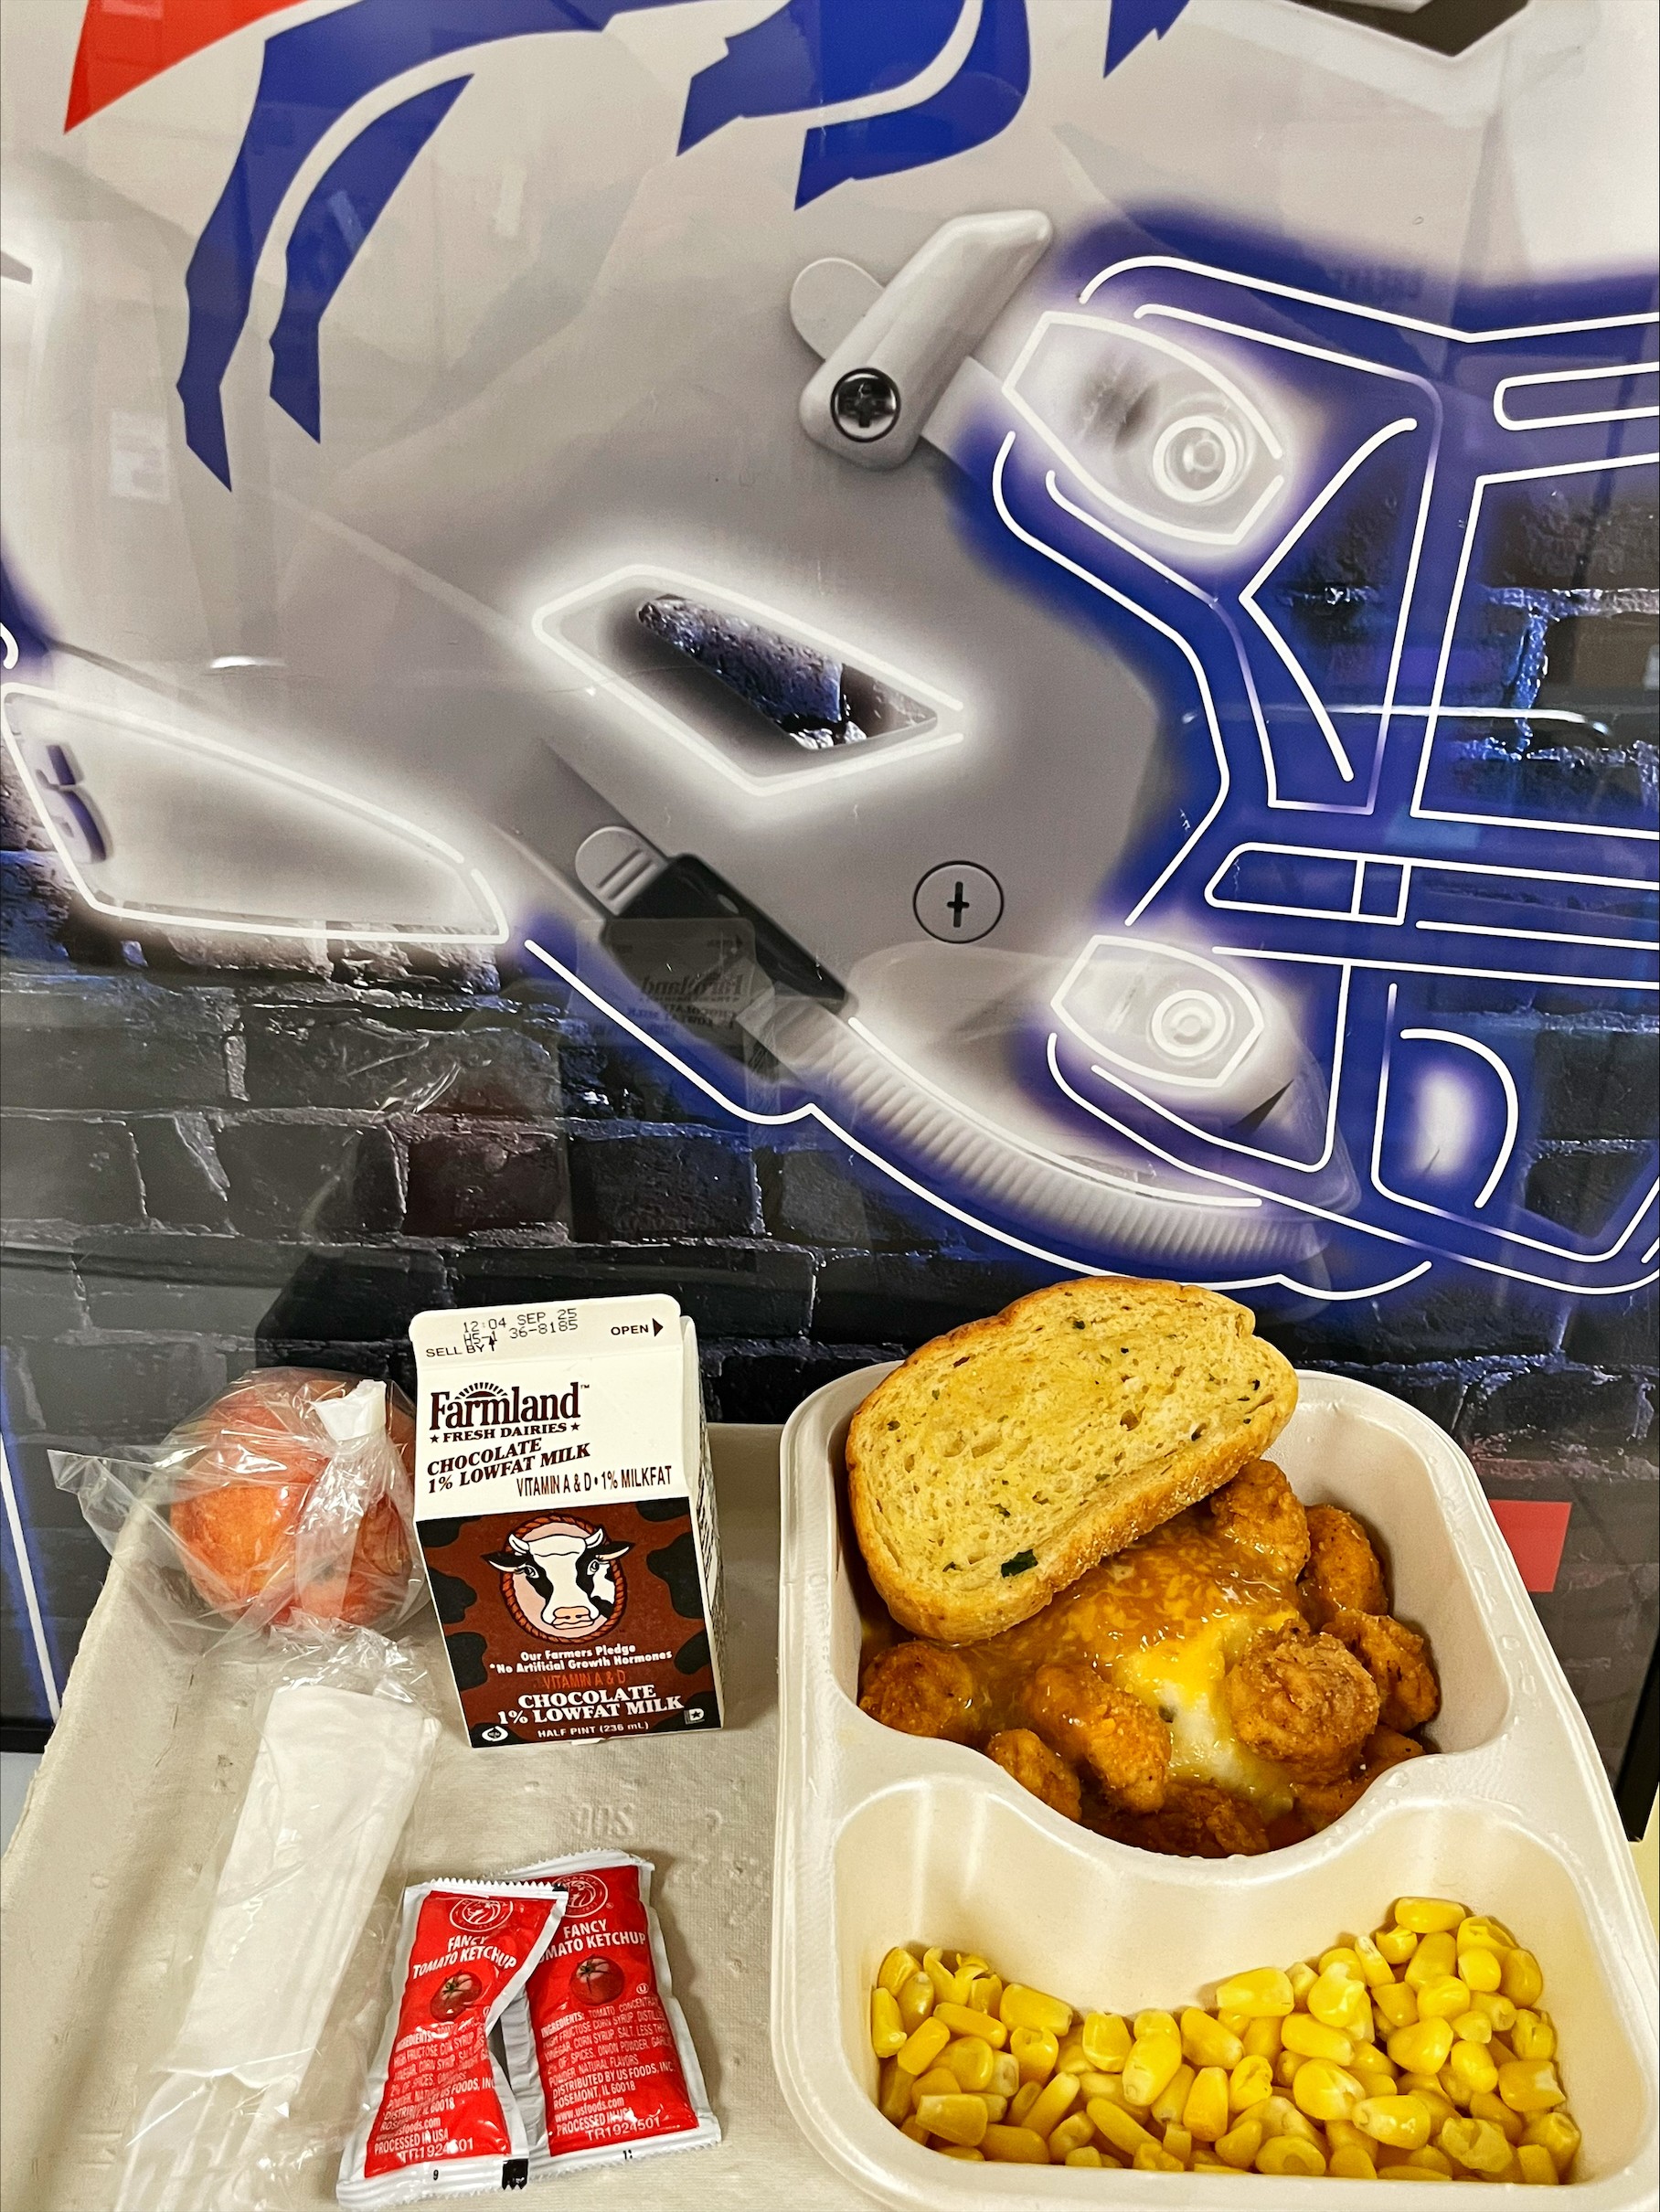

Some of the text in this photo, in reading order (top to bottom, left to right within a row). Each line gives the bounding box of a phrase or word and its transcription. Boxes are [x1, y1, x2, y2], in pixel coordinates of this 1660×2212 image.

[463, 1308, 577, 1334] 12:04 SEP 25
[509, 1319, 579, 1339] 36-8185
[611, 1324, 649, 1335] OPEN
[425, 1344, 484, 1357] SELL BY
[429, 1382, 581, 1430] Farmland
[442, 1422, 568, 1443] FRESH DAIRIES
[427, 1437, 542, 1476] CHOCOLATE
[428, 1442, 591, 1494] 1% LOWFAT MILK
[516, 1465, 672, 1497] VITAMIN A & D 1% MILKFAT
[516, 1660, 565, 1673] Artificial
[568, 1657, 611, 1670] Growth
[613, 1650, 673, 1665] Hormones
[520, 1643, 636, 1663] Our Farmers Pledge
[541, 1668, 626, 1690] VITAMIN A & D
[517, 1684, 657, 1710] CHOCOLATE
[498, 1696, 685, 1725] 1% LOWFAT MILK
[537, 1720, 649, 1738] HALF PINT (236 mL)
[563, 1919, 607, 1939] FANCY
[586, 1931, 646, 1949] KETCHUP
[447, 1934, 490, 1953] FANCY
[413, 1945, 517, 1980] TOMATO KETCHUP
[589, 2005, 616, 2019] TOMATO
[559, 2021, 591, 2042] FRUCTOSE
[593, 2016, 612, 2030] CORN
[573, 2035, 592, 2050] CORN
[637, 2024, 653, 2036] LESS
[597, 2042, 620, 2056] ONION
[578, 2058, 609, 2075] NATURAL
[610, 2054, 639, 2068] FLAVORS
[452, 2078, 480, 2095] FOODS,
[552, 2072, 603, 2100] DISTRIBUTED
[604, 2071, 615, 2082] BY
[617, 2068, 628, 2080] US
[629, 2064, 659, 2079] FOODS,
[430, 2097, 455, 2113] 60018
[553, 2080, 636, 2111] ROSEMONT, IL 60018
[554, 2096, 625, 2123] www.usfoods.com
[556, 2113, 606, 2137] PROCESSED
[585, 2115, 661, 2142] TR1924501
[374, 2132, 420, 2155] PROCESSED
[432, 2128, 449, 2141] USA
[432, 2169, 439, 2181] 9
